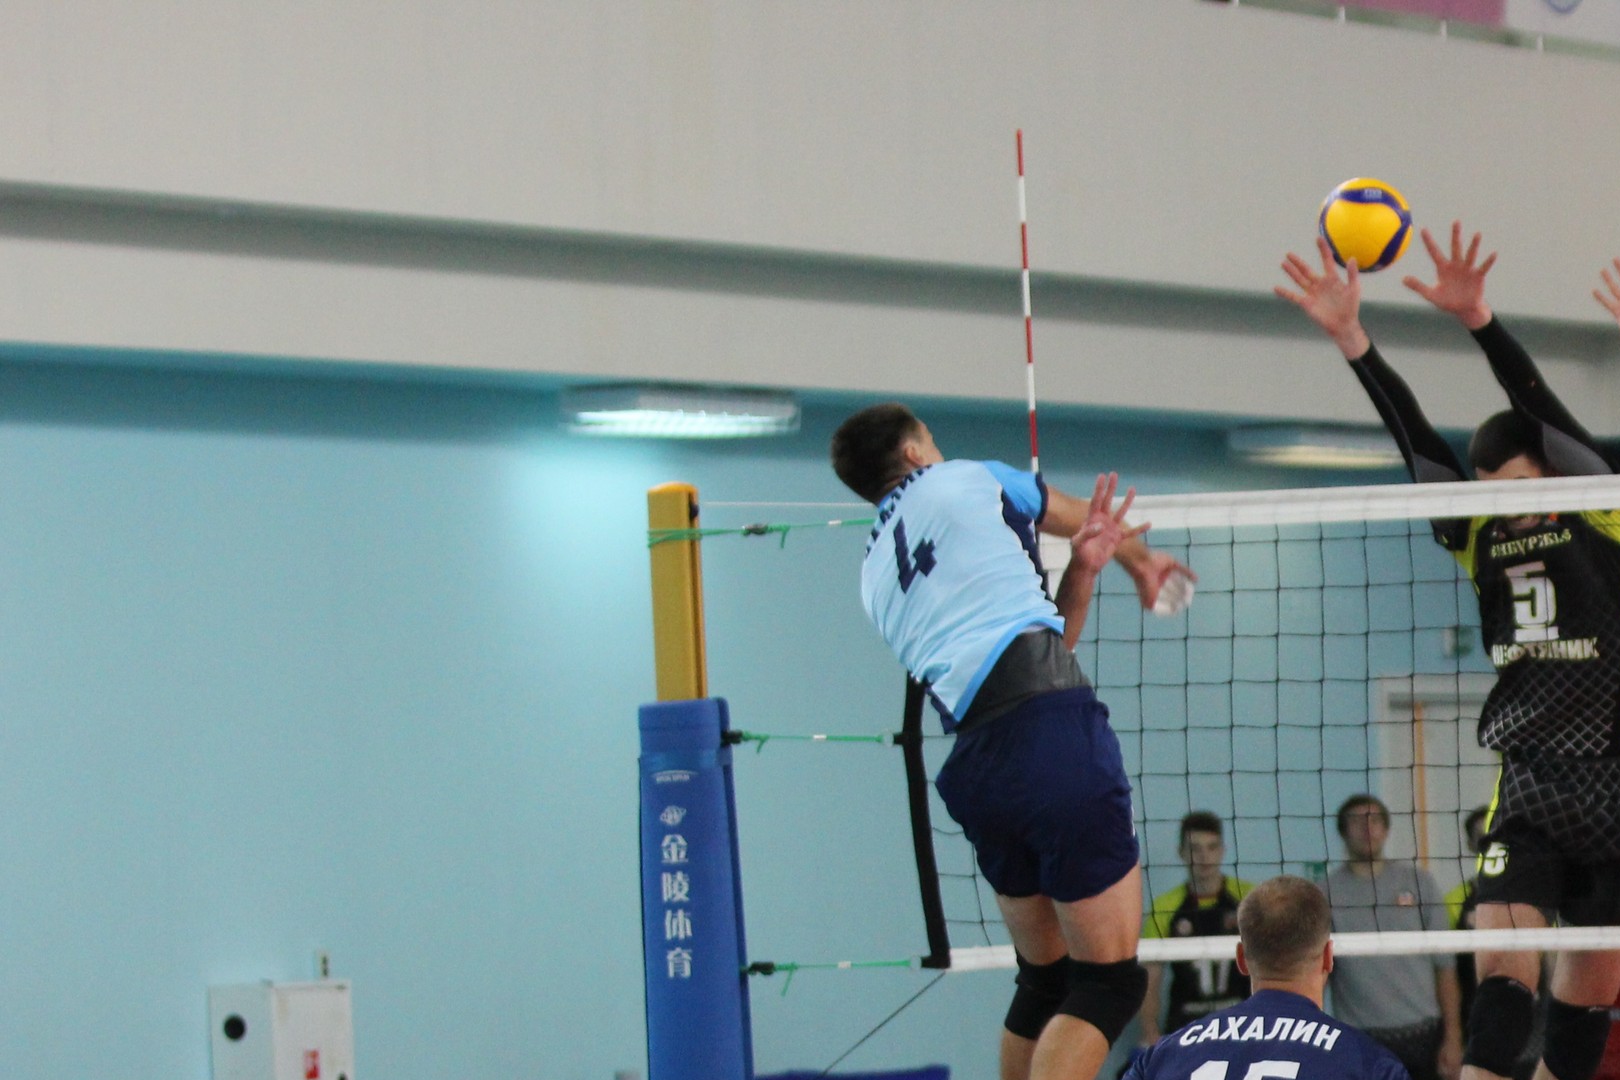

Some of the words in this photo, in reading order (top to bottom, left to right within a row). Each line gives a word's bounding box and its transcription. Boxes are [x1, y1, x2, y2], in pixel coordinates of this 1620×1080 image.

[893, 516, 938, 595] 4
[1505, 560, 1556, 628] 5
[661, 833, 693, 979] 金陵体育
[1179, 1016, 1341, 1051] САХАЛИН
